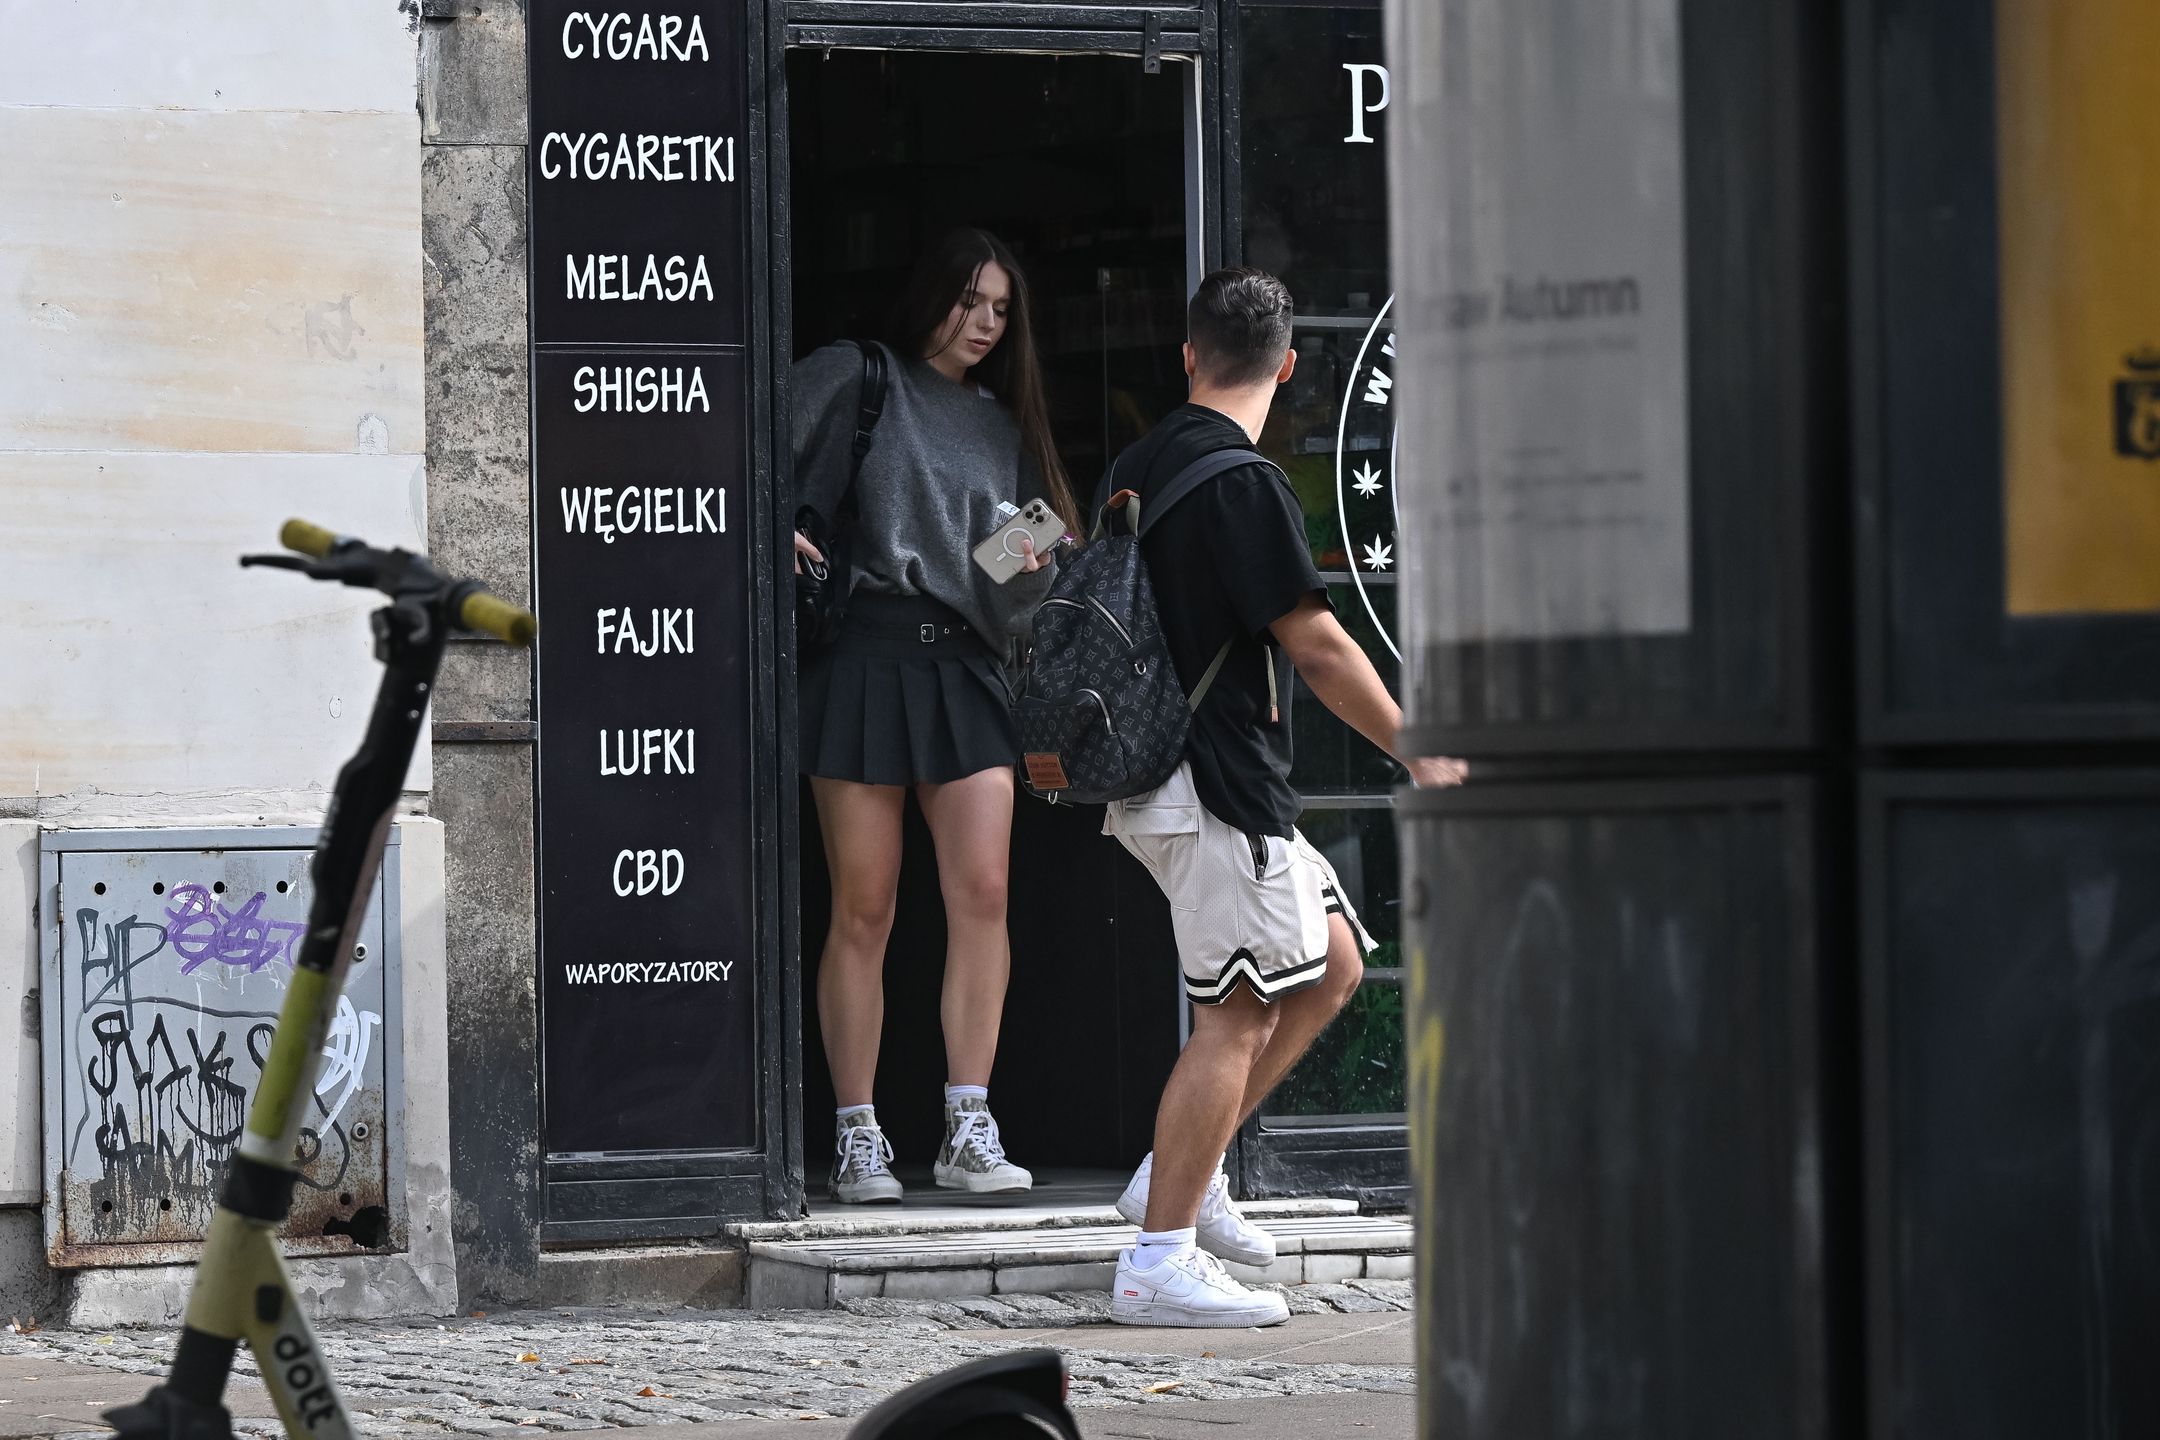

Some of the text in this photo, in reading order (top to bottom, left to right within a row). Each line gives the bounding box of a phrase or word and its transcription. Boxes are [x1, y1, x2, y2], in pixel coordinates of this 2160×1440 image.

[562, 11, 710, 62] CYGARA
[540, 131, 735, 183] CYGARETKI
[566, 253, 714, 302] MELASA
[573, 365, 710, 413] SHISHA
[560, 485, 727, 544] WĘGIELKI
[597, 606, 694, 657] FAJKI
[600, 728, 695, 776] LUFKI
[612, 848, 685, 897] CBD
[565, 960, 734, 985] WAPORYZATORY
[274, 1334, 336, 1430] dott
